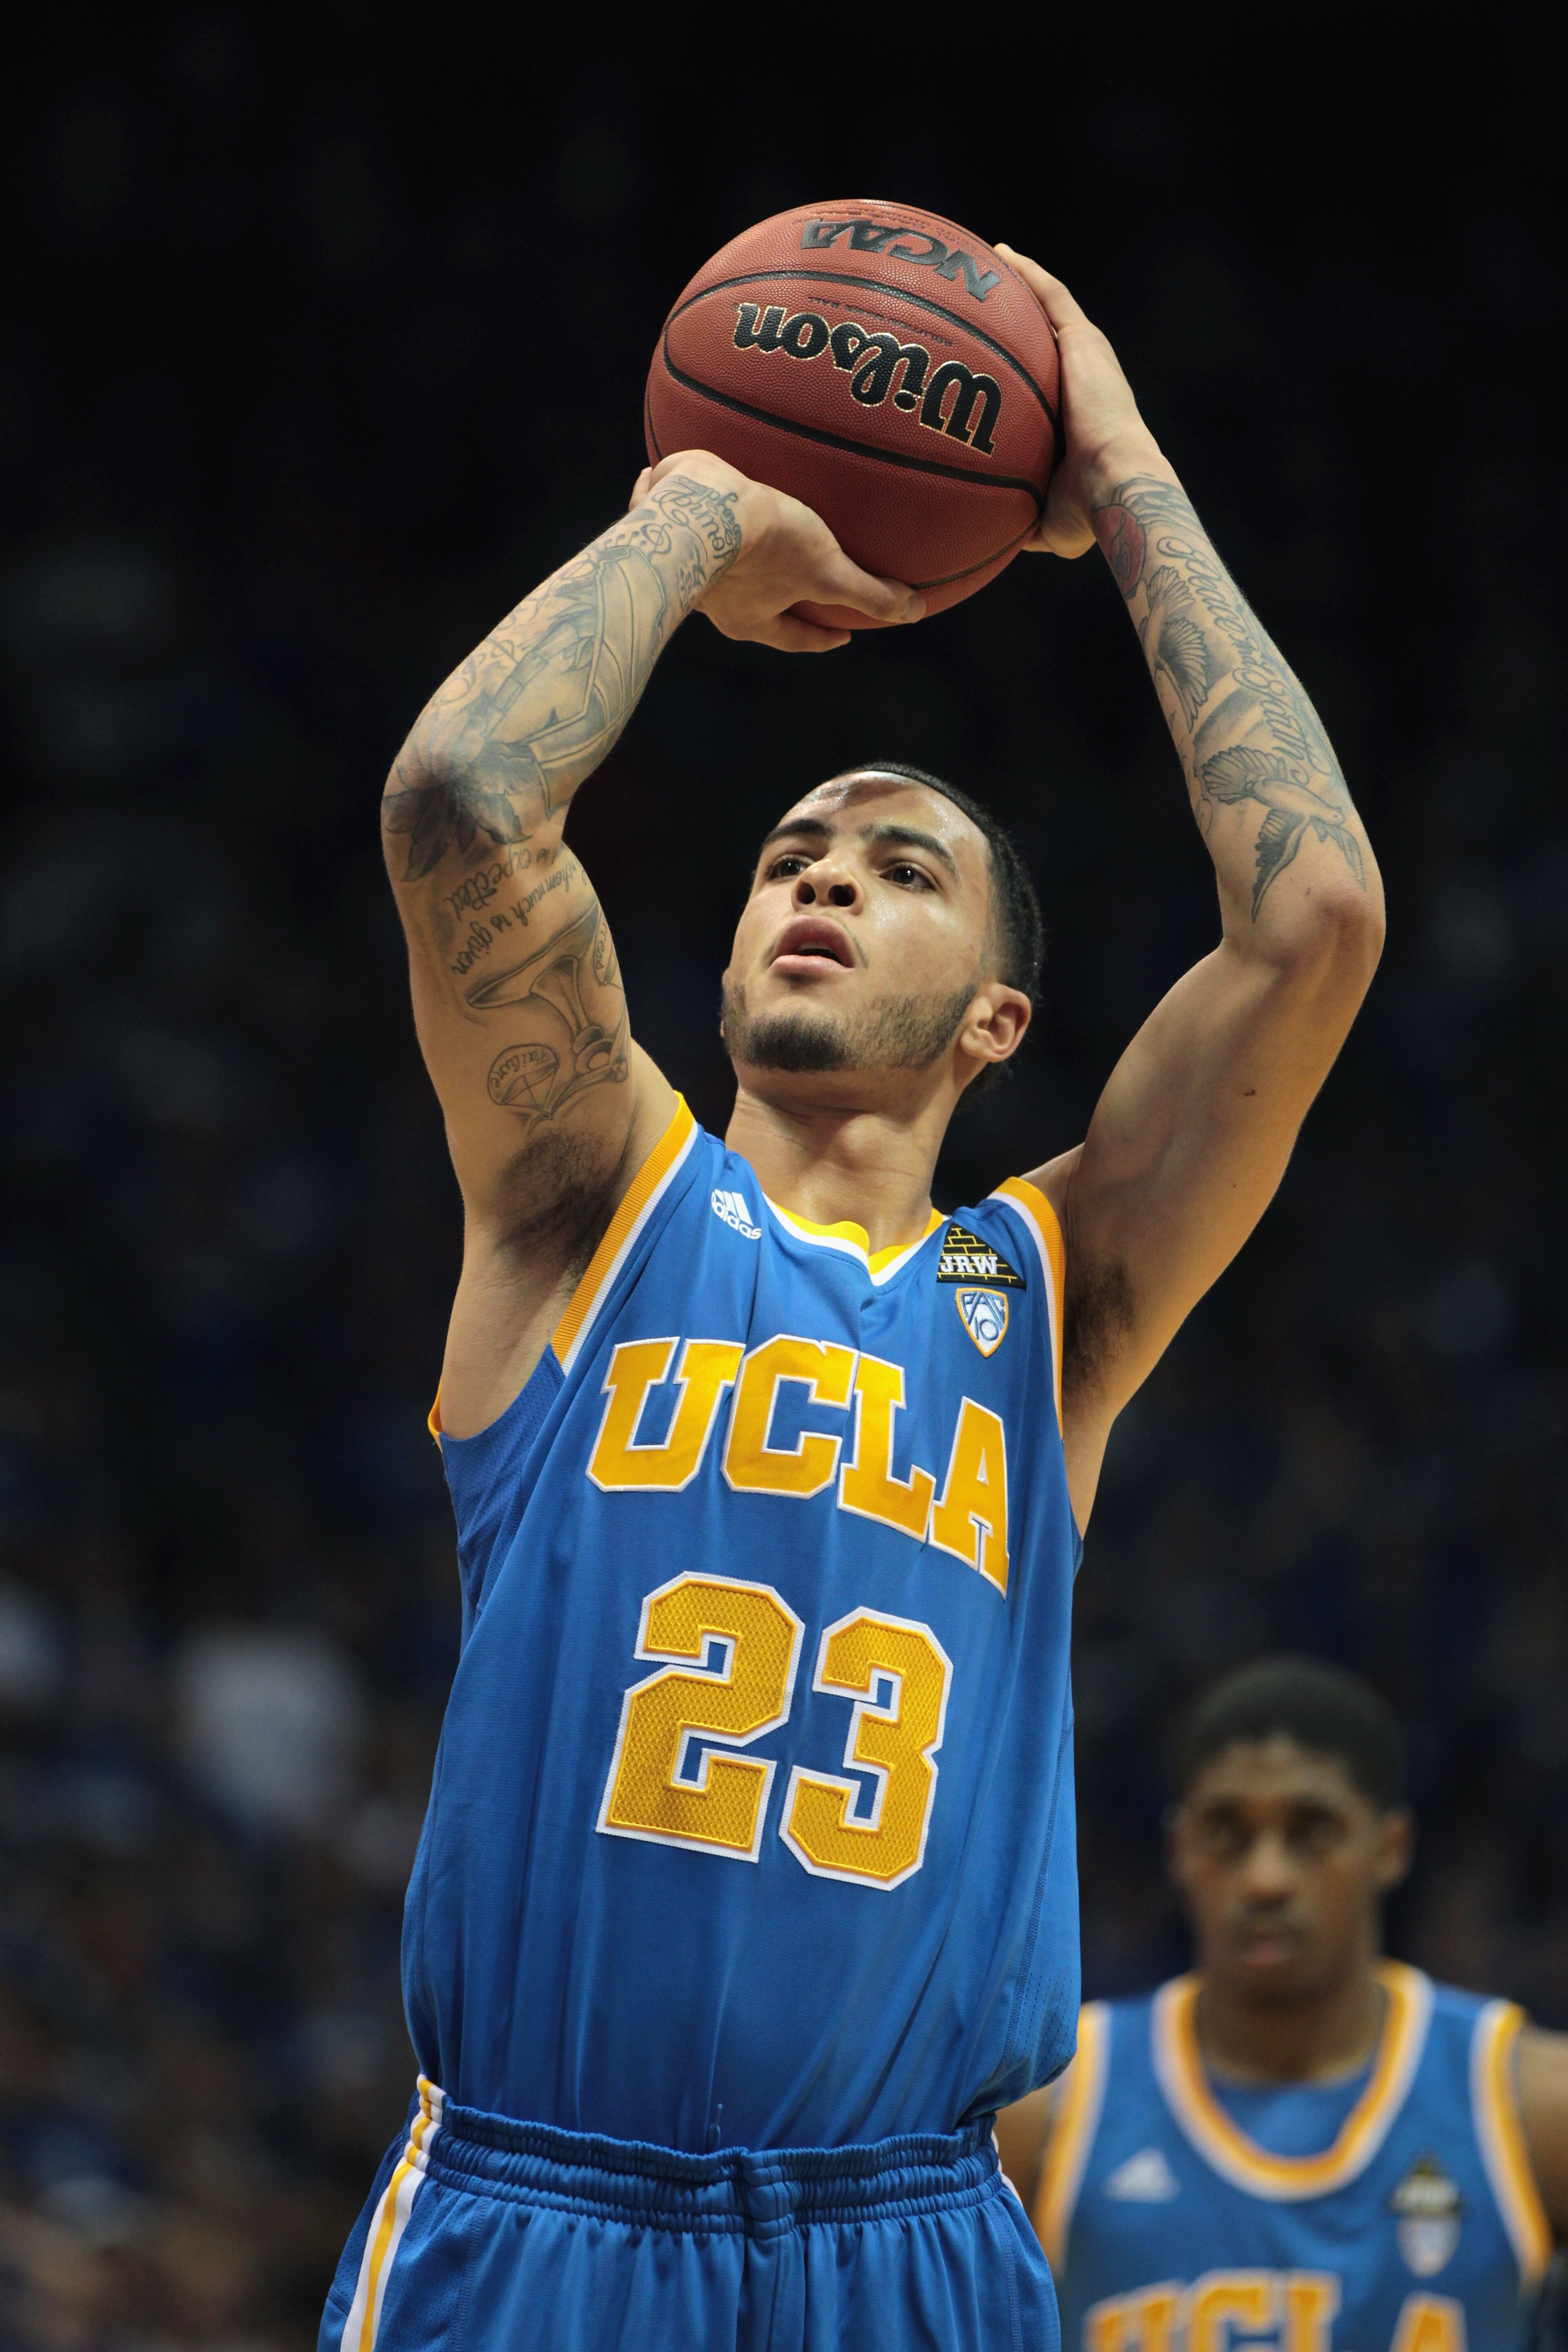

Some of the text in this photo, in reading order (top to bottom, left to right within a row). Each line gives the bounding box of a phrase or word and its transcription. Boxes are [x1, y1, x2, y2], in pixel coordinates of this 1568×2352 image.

[801, 219, 1001, 302] NCAA
[808, 296, 839, 309] BALL
[845, 305, 883, 321] GAME
[733, 302, 1003, 456] Wilson
[1157, 537, 1245, 633] Peace
[490, 913, 512, 933] is
[509, 884, 545, 926] much
[451, 921, 493, 975] given
[711, 1190, 762, 1240] adidas
[940, 1255, 998, 1275] JRW
[586, 1334, 1010, 1600] UCLA
[596, 1570, 953, 1891] 23
